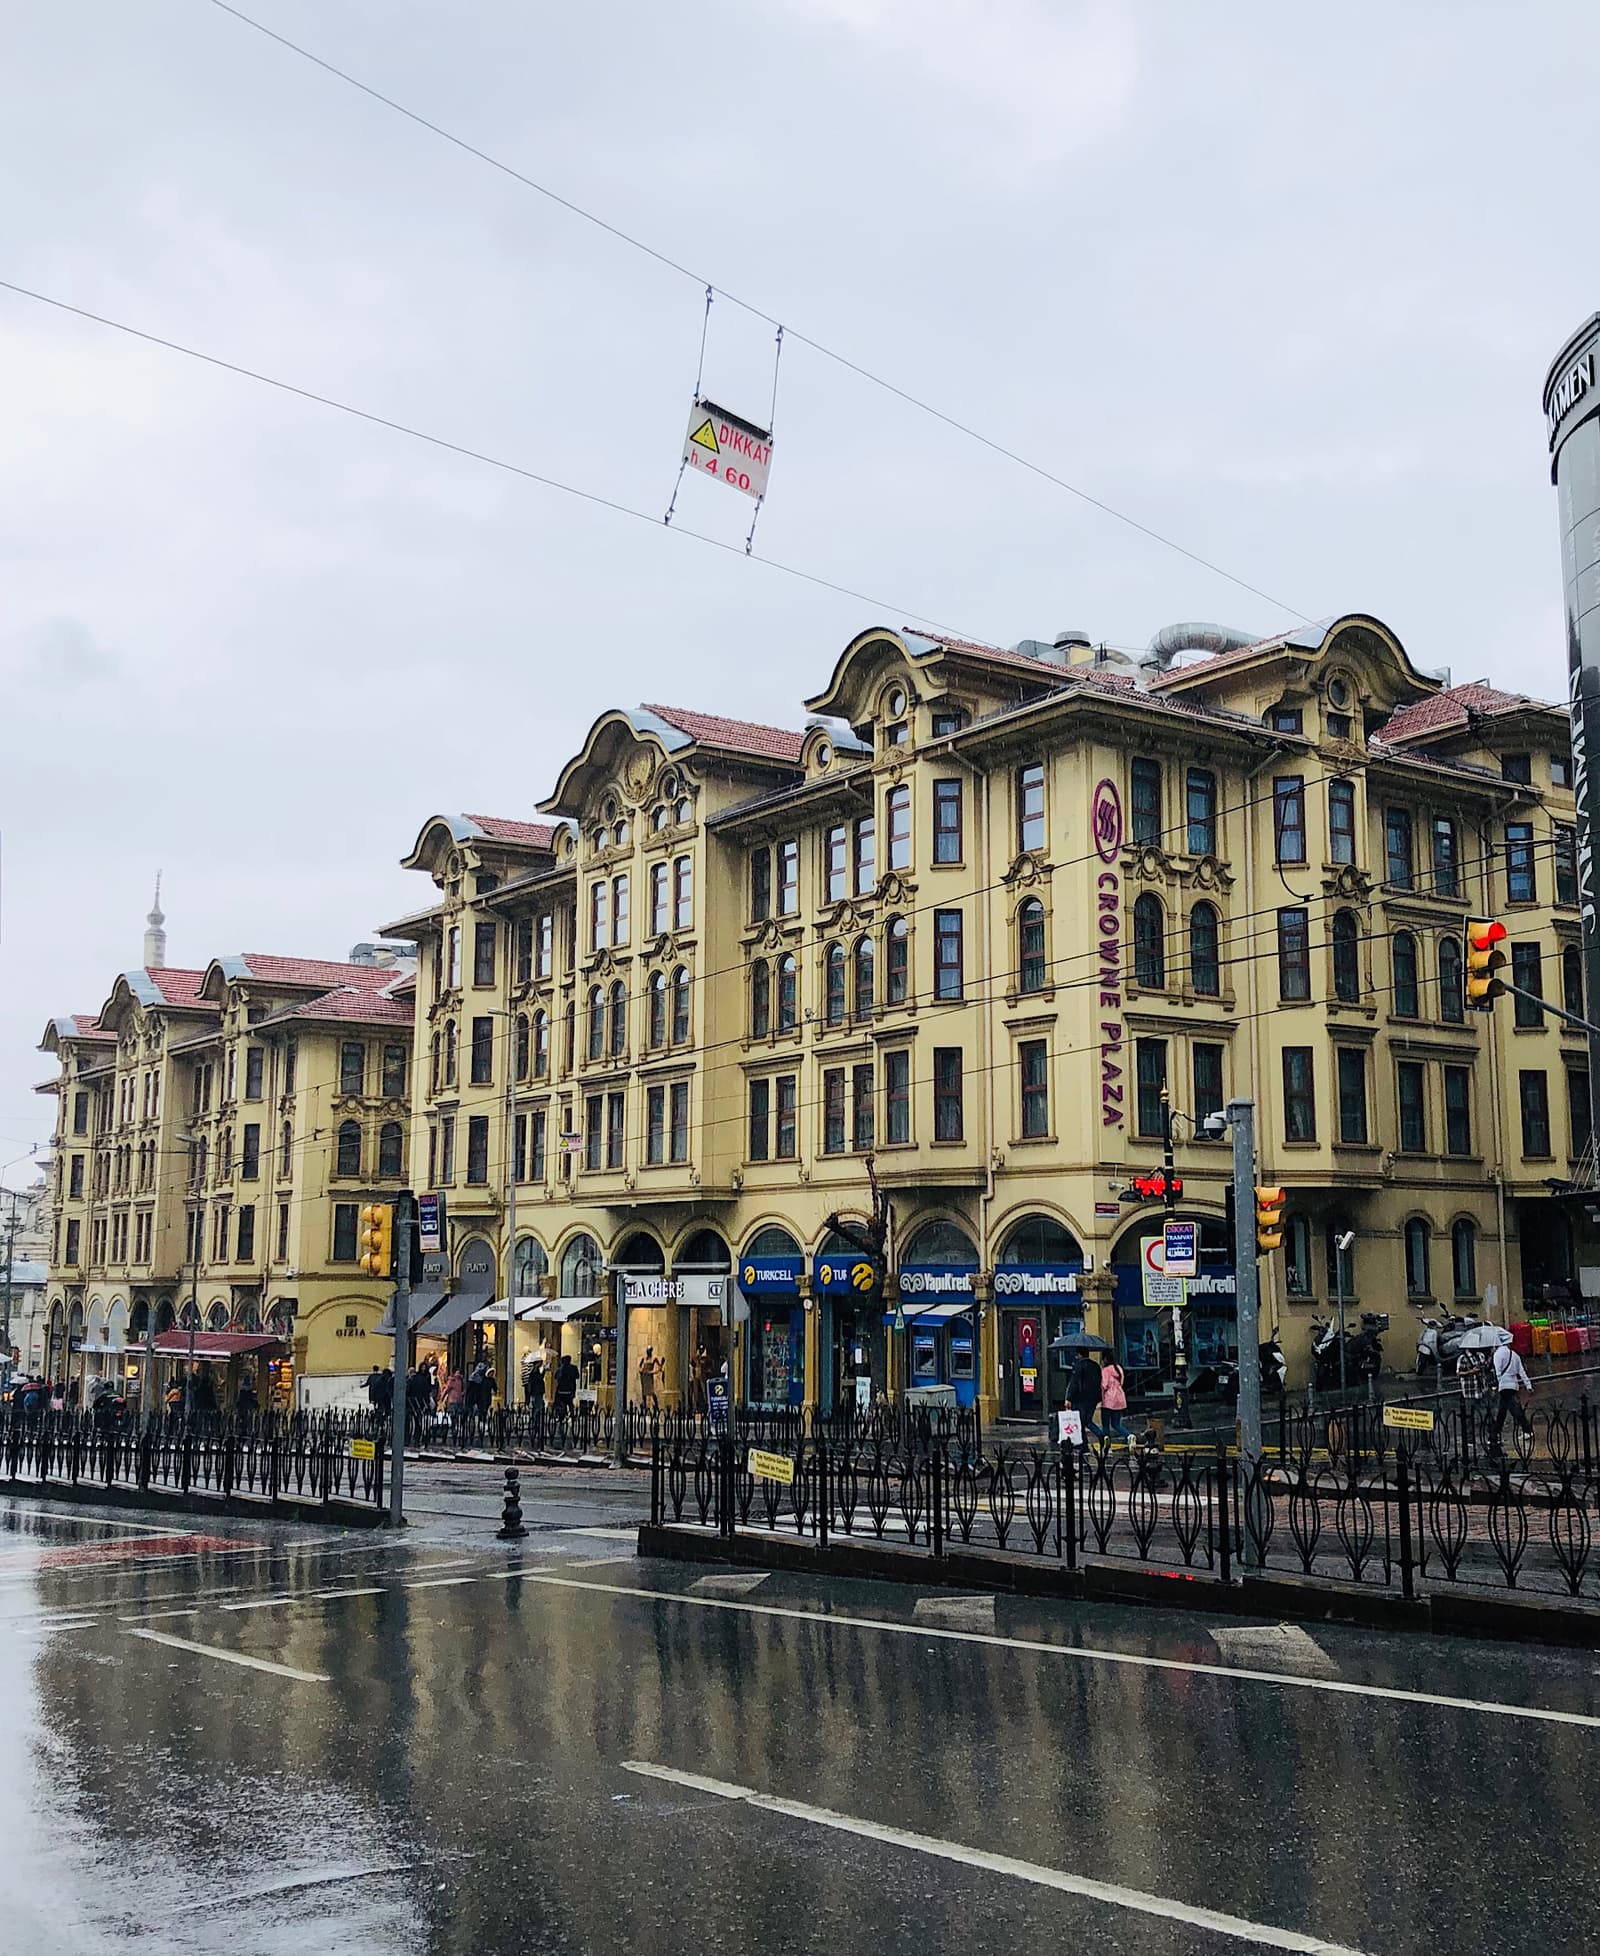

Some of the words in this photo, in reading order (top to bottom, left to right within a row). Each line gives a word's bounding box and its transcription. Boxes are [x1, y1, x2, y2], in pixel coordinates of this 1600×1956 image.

[1098, 872, 1121, 1008] CROWNE
[1101, 1022, 1124, 1126] PLAZA
[646, 1279, 684, 1298] CHÈRE
[756, 1269, 793, 1281] TURKCELL
